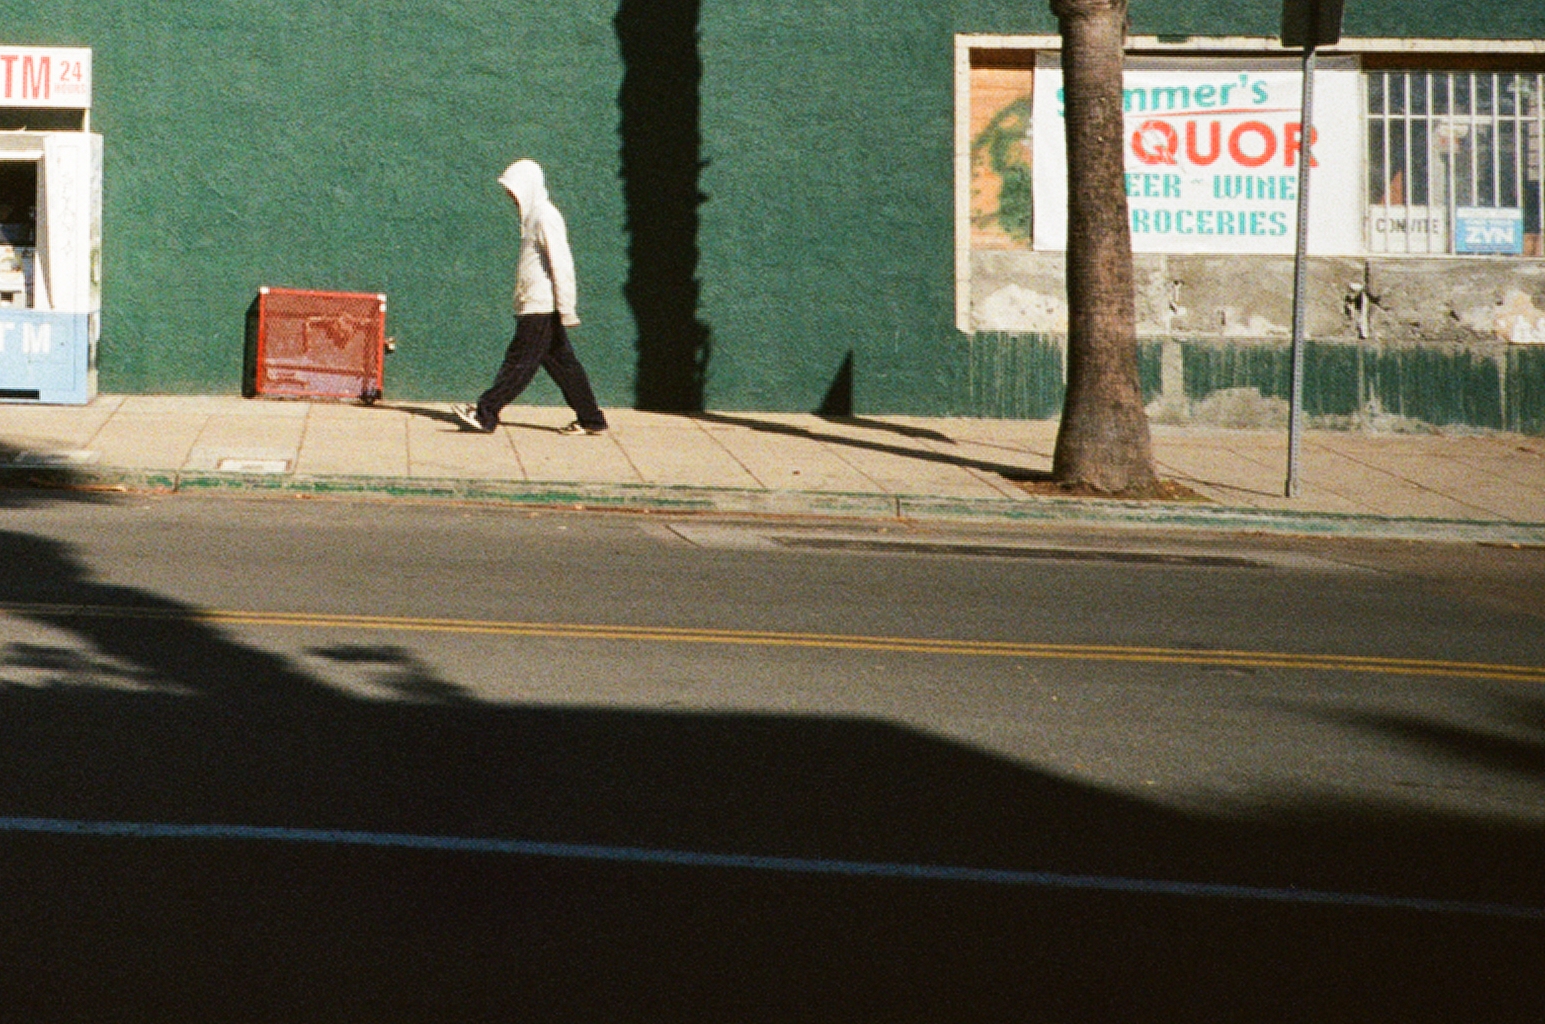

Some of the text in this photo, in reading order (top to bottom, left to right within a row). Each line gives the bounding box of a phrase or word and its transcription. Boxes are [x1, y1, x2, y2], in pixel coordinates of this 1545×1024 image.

[60, 60, 83, 82] 24
[1131, 120, 1319, 167] QUOR
[1124, 172, 1296, 200] EER WINE
[1132, 208, 1288, 236] ROCERIES
[1465, 226, 1514, 244] ZYN
